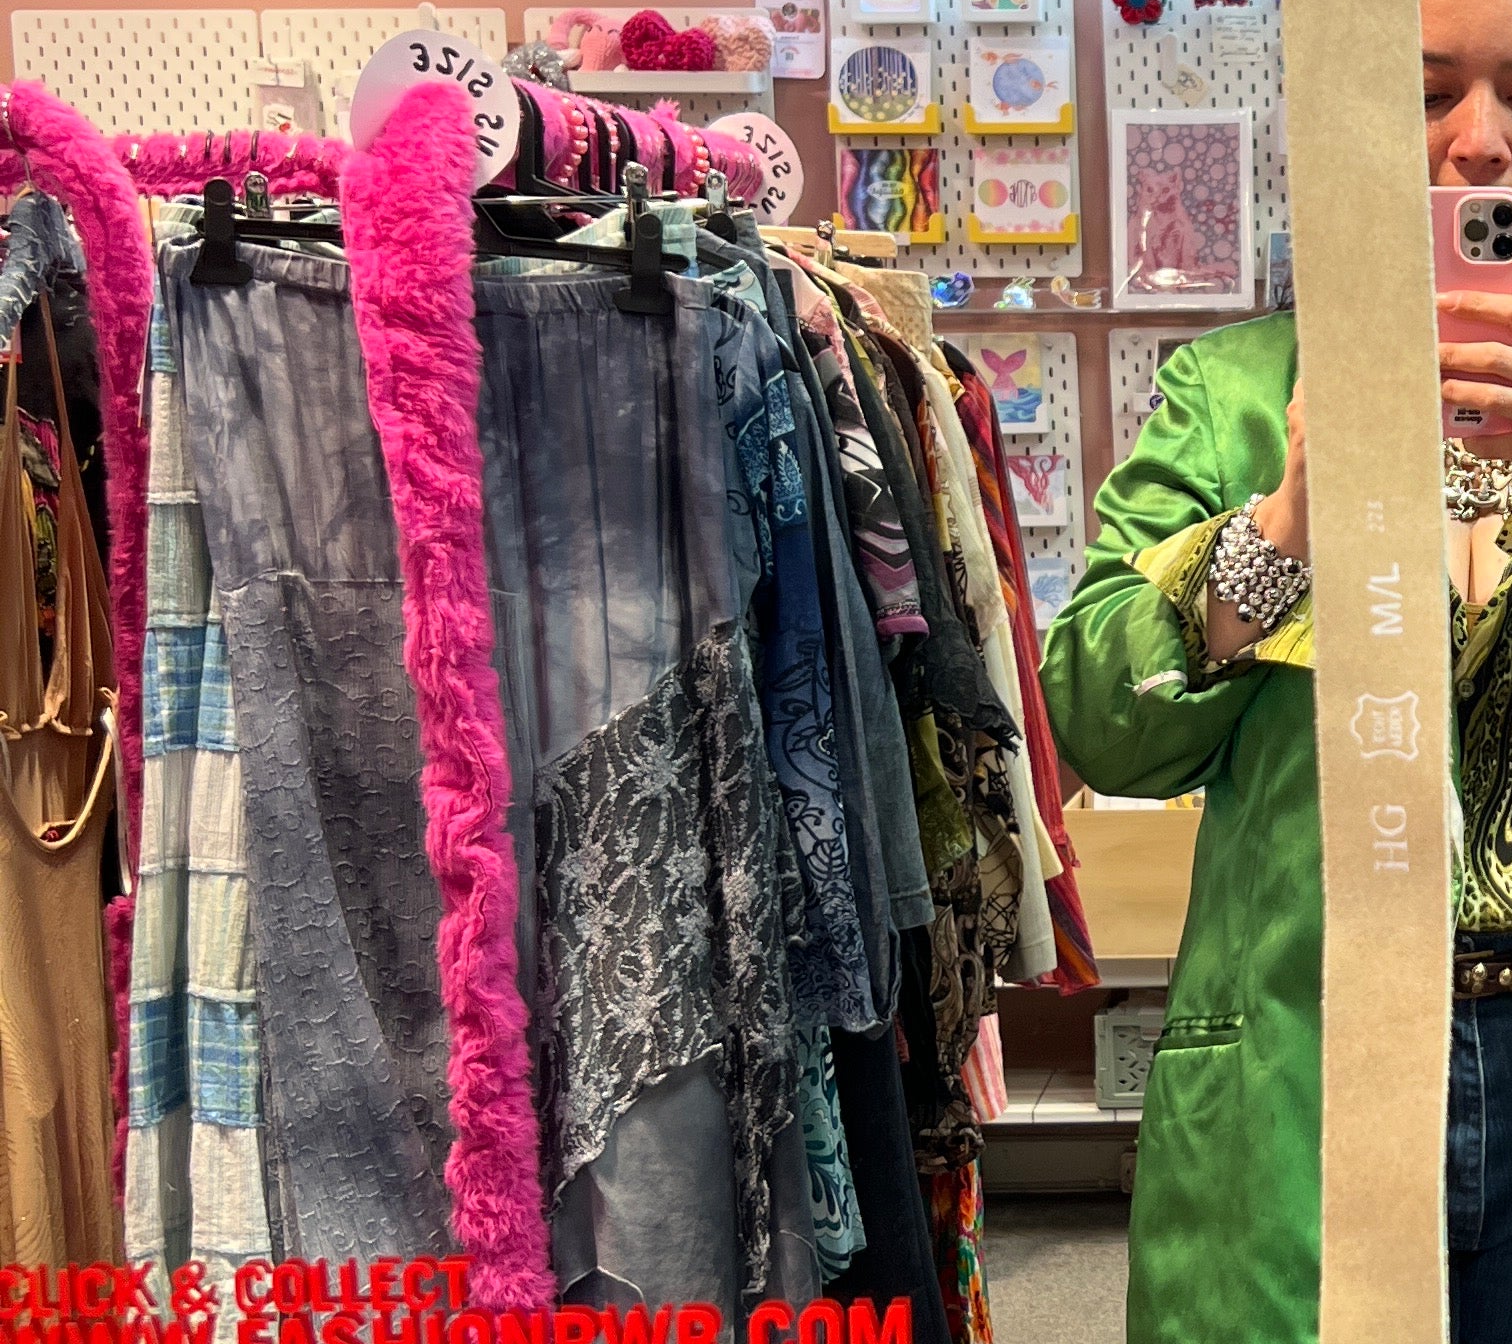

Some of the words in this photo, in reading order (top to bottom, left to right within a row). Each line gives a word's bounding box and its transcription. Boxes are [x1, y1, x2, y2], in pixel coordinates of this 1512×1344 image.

[1366, 561, 1403, 635] M/L
[1370, 805, 1410, 872] HG
[0, 1261, 158, 1318] CLICK
[171, 1260, 220, 1316] &
[234, 1256, 470, 1314] COLLECT
